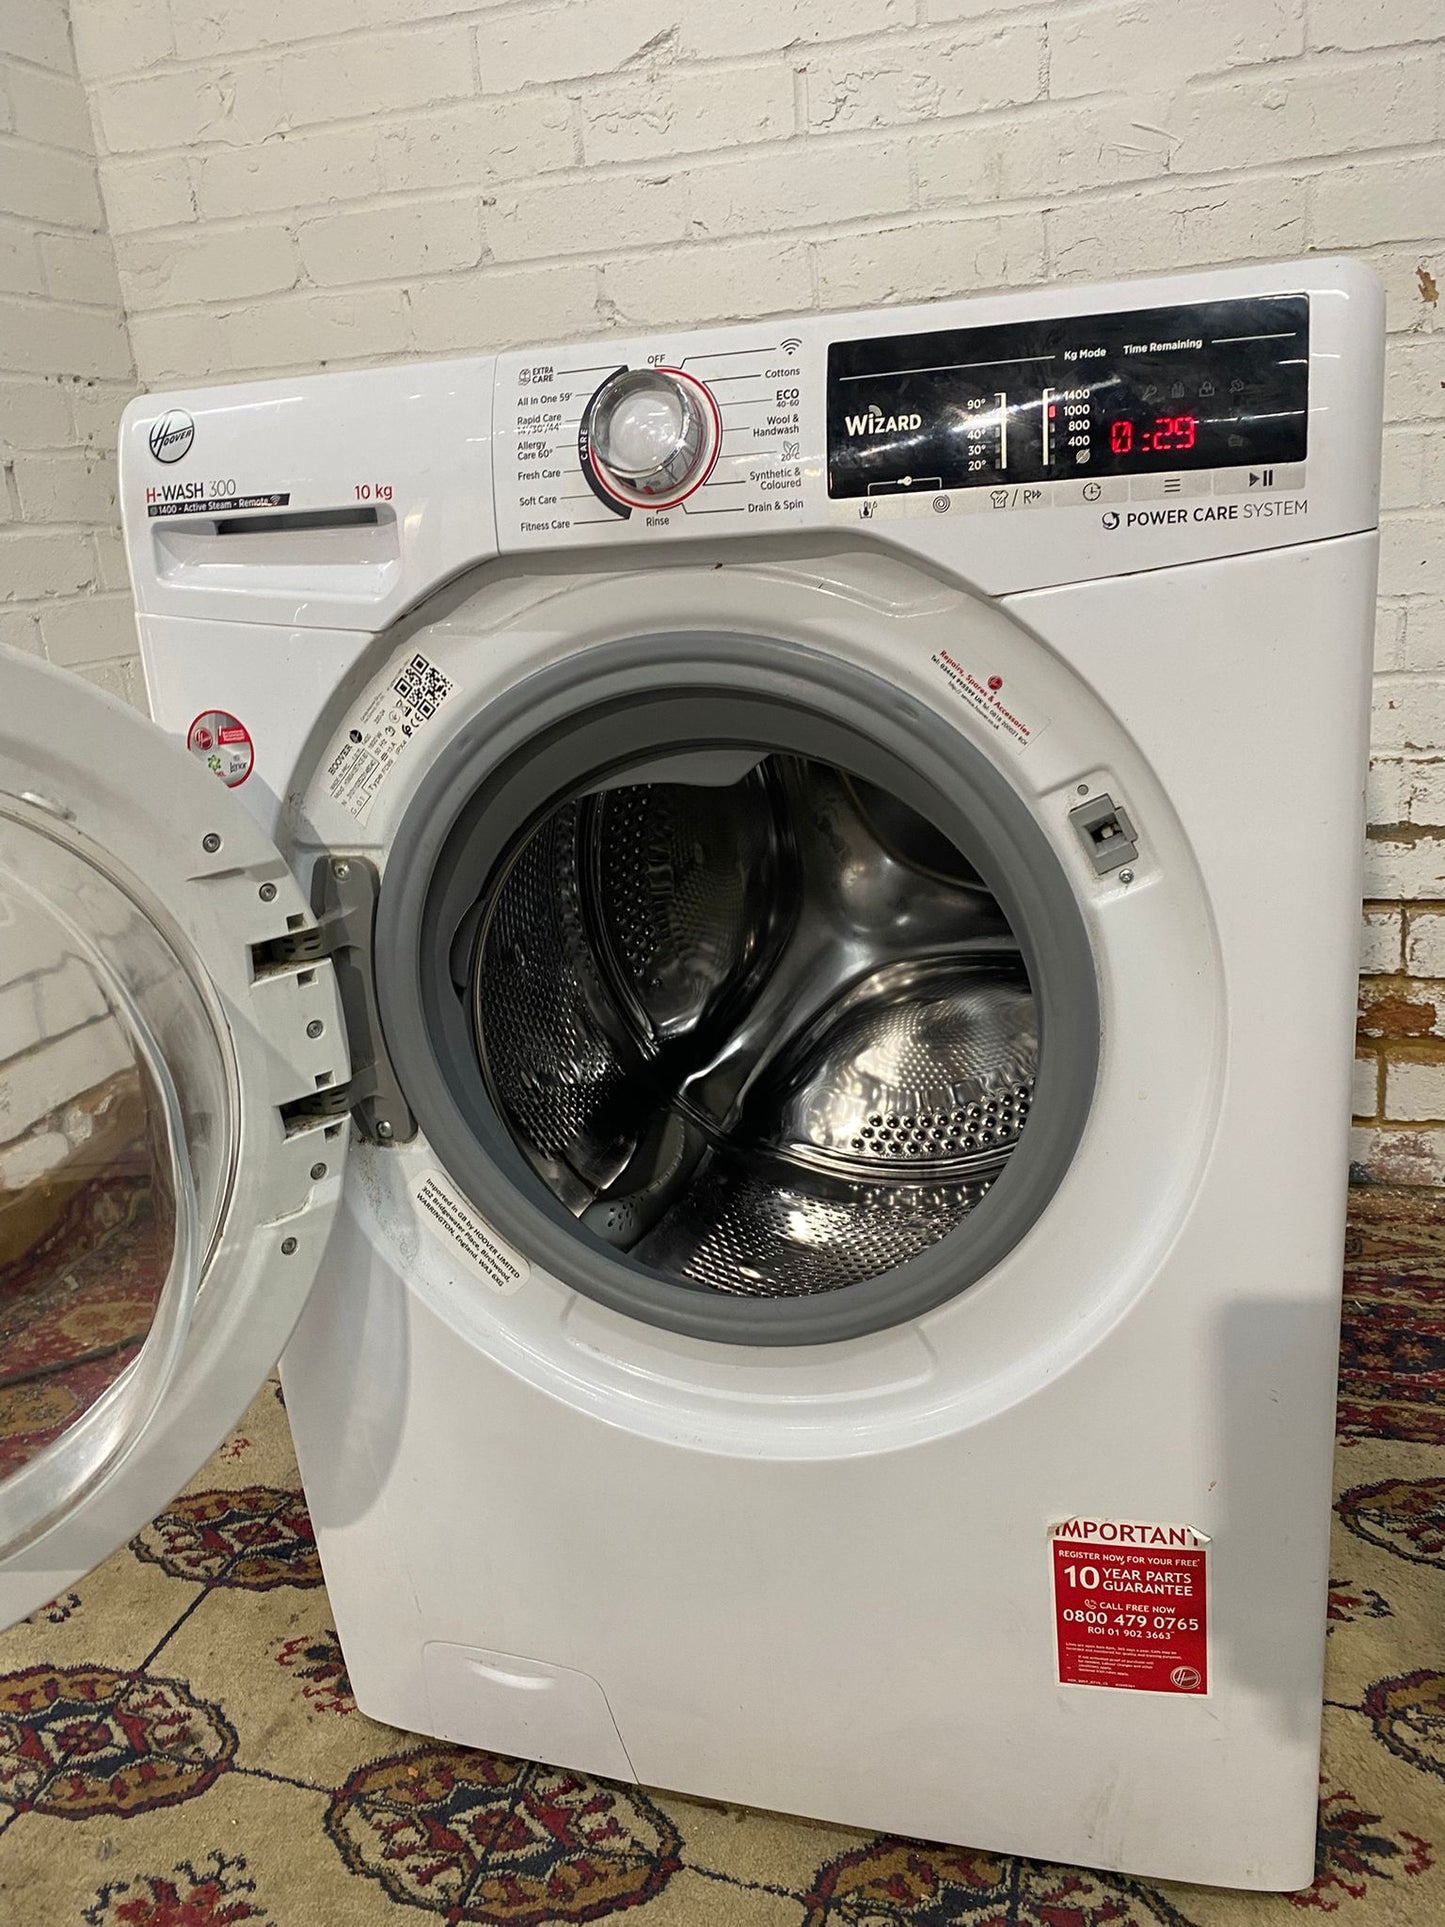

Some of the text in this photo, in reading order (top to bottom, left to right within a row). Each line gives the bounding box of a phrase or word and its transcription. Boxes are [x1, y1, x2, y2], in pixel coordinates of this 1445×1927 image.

[1123, 339, 1202, 355] Time Remaining
[647, 354, 665, 364] OFF
[1064, 348, 1107, 361] Kg Mode
[532, 366, 553, 376] EXTRA
[765, 368, 800, 379] Cottons
[532, 374, 553, 384] CARE
[776, 388, 799, 400] ECO
[1063, 389, 1090, 401] 1400
[517, 397, 528, 406] All
[530, 396, 538, 405] In
[540, 395, 557, 404] One
[776, 400, 799, 408] 40-60
[967, 398, 986, 409] 90°
[1064, 404, 1090, 416] 1000
[517, 414, 561, 426] Rapid Care
[767, 414, 799, 425] Wool &
[1068, 419, 1090, 431] 800
[753, 424, 799, 437] Handwash
[967, 429, 986, 440] 40°
[1111, 416, 1196, 453] 0:29
[151, 419, 192, 458] HOOVER
[580, 429, 588, 460] CARE
[1068, 435, 1090, 447] 400
[518, 441, 546, 452] Allergy
[968, 445, 986, 455] 30°
[518, 449, 553, 460] Care 60°
[968, 460, 986, 471] 20°
[518, 469, 561, 480] Fresh Care
[750, 467, 800, 481] Synthetic &
[760, 477, 801, 490] Coloured
[146, 479, 236, 503] H-WASH 300
[355, 483, 392, 500] 10 kg
[159, 497, 269, 514] 1400 Active Steam Remote
[520, 495, 557, 506] Soft Care
[748, 499, 804, 512] Drain & Spin
[1127, 500, 1308, 527] POWER CARE SYSTEM
[520, 520, 570, 532] Fitness Care
[646, 516, 669, 527] Rinse
[940, 650, 965, 676] Repairs,
[966, 674, 987, 696] Spares
[994, 701, 1030, 735] Accessories
[975, 695, 983, 704] UK
[368, 772, 384, 792] Type
[426, 1178, 520, 1279] Imported in GB by HOOVER LIMITED
[417, 1193, 455, 1237] WARRINGTON,
[479, 1261, 493, 1275] WA3
[491, 1274, 504, 1287] 6XG
[422, 1187, 510, 1283] 302 Bridgewater Place, Birchwood,
[1059, 1550, 1100, 1560] REGISTER
[1149, 1557, 1173, 1566] YOUR
[1064, 1565, 1100, 1590] 10
[1102, 1568, 1191, 1584] YEAR PARTS
[1103, 1581, 1193, 1596] GUARANTEE
[1099, 1601, 1175, 1614] CALL FREE NOW
[1063, 1609, 1199, 1631] 0800 479 0765
[1088, 1626, 1104, 1635] ROI
[1108, 1628, 1120, 1636] 01
[1123, 1630, 1142, 1638] 902
